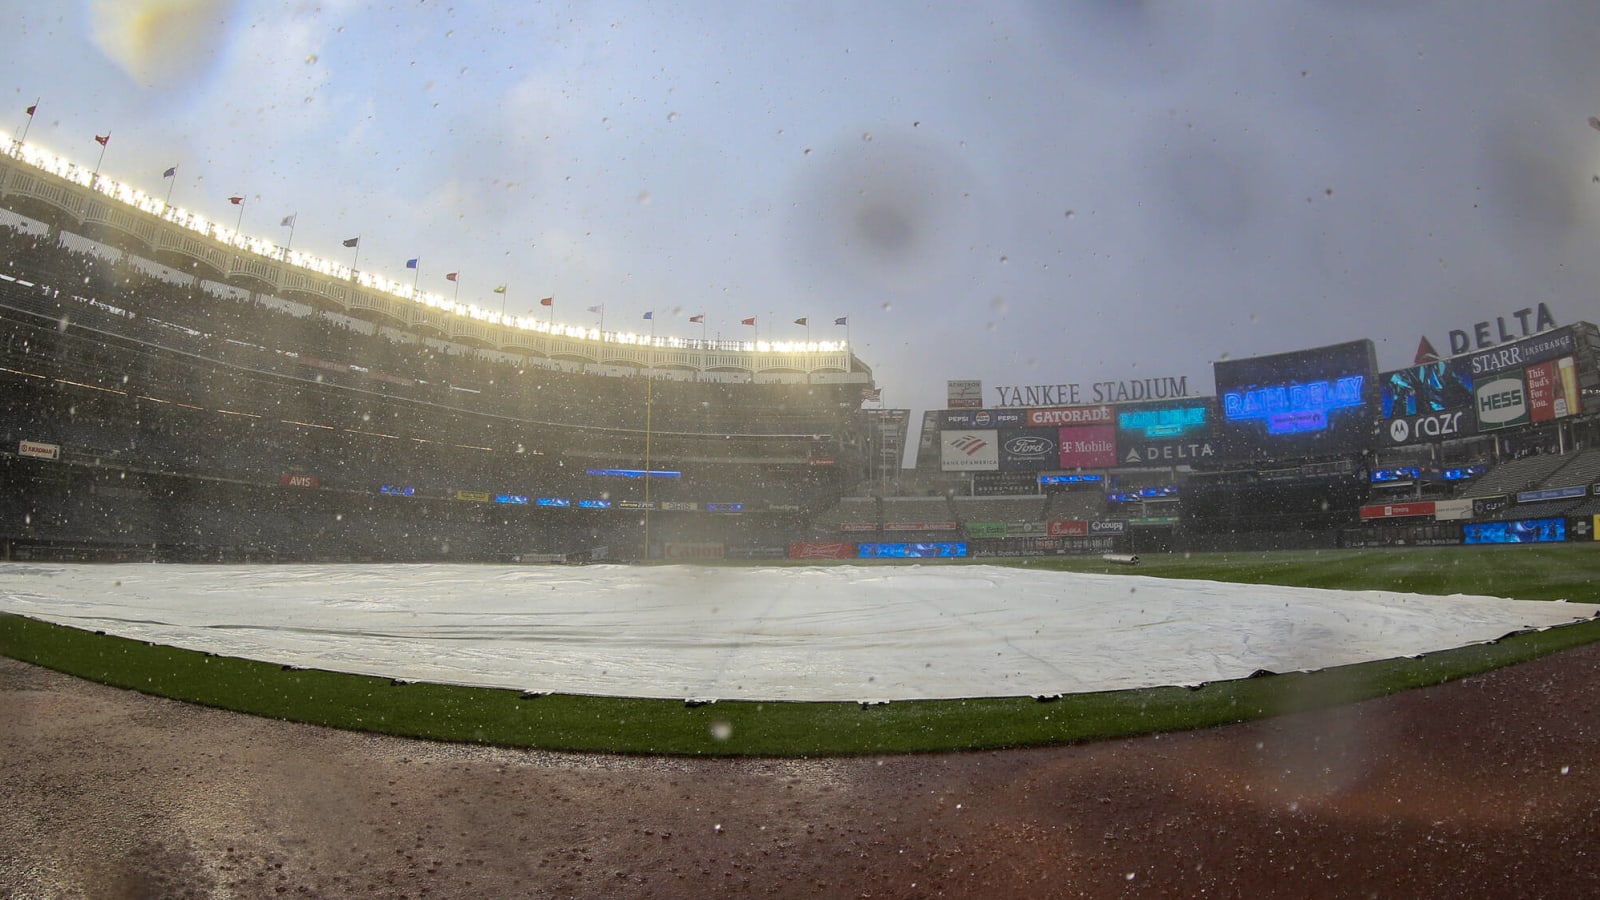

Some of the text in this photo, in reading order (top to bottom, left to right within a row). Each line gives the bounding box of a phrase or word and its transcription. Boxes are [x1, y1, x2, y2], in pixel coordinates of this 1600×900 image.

[1449, 303, 1554, 355] DELTA
[1472, 335, 1572, 374] STARR INSURANCE
[1527, 367, 1545, 379] This
[995, 375, 1189, 407] YANKEE STADIUM
[1528, 378, 1549, 390] Bud's
[1481, 390, 1522, 412] HESS
[1531, 390, 1543, 399] For
[1032, 407, 1110, 423] GATORADE
[1415, 411, 1463, 438] razr
[1013, 439, 1044, 453] Ford
[1074, 440, 1112, 453] Mobile
[1147, 444, 1212, 459] DELTA
[289, 475, 311, 487] AVIS
